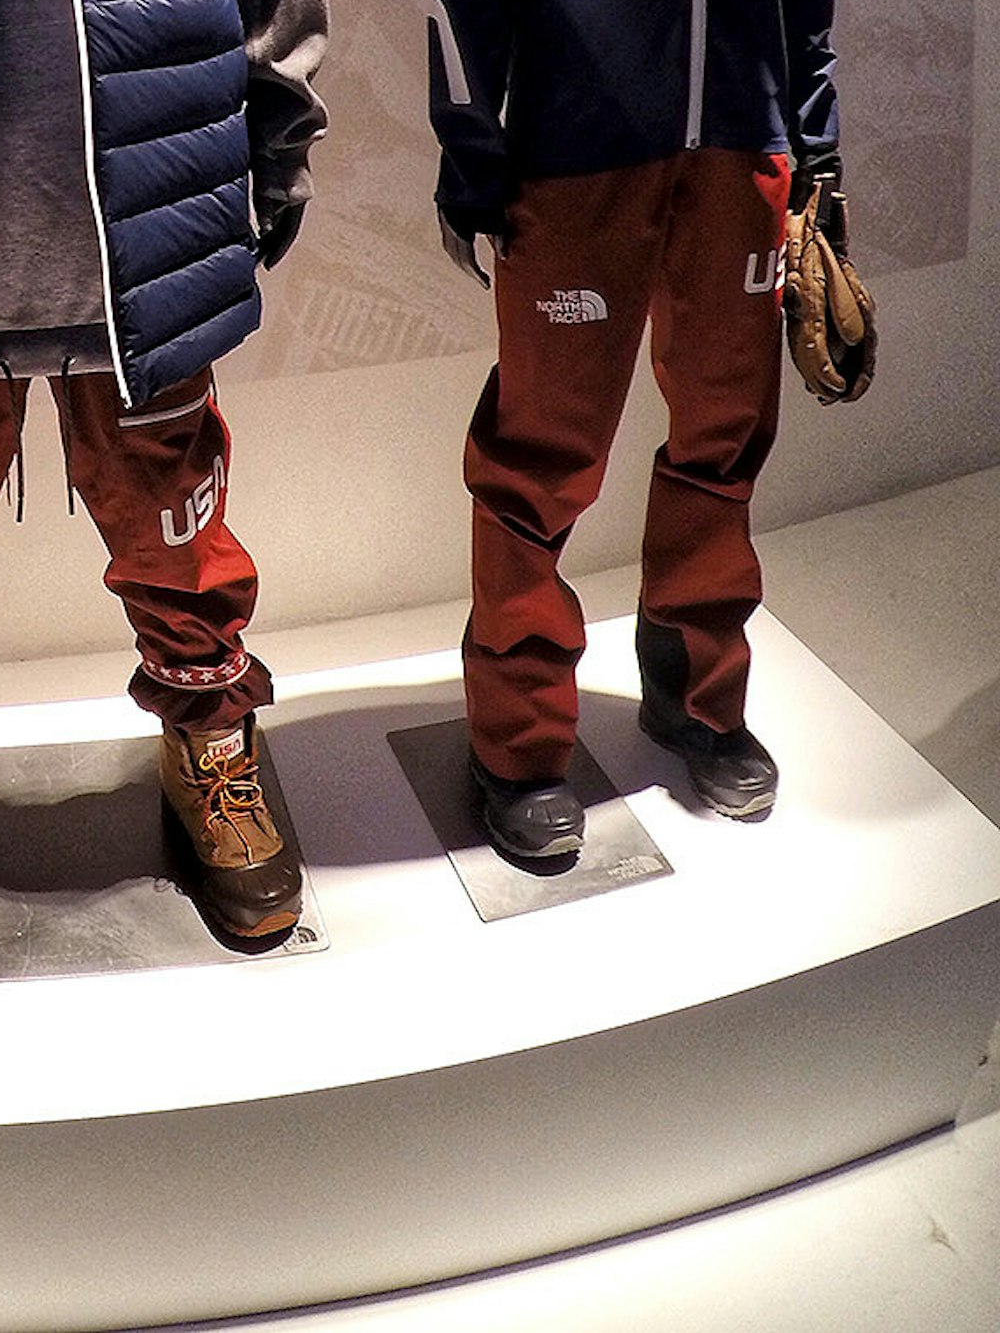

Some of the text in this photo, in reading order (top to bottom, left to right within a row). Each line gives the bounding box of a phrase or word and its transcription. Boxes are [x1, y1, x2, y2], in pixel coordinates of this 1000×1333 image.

[552, 289, 580, 302] THE
[535, 300, 581, 313] NORTH
[548, 312, 582, 324] FACE
